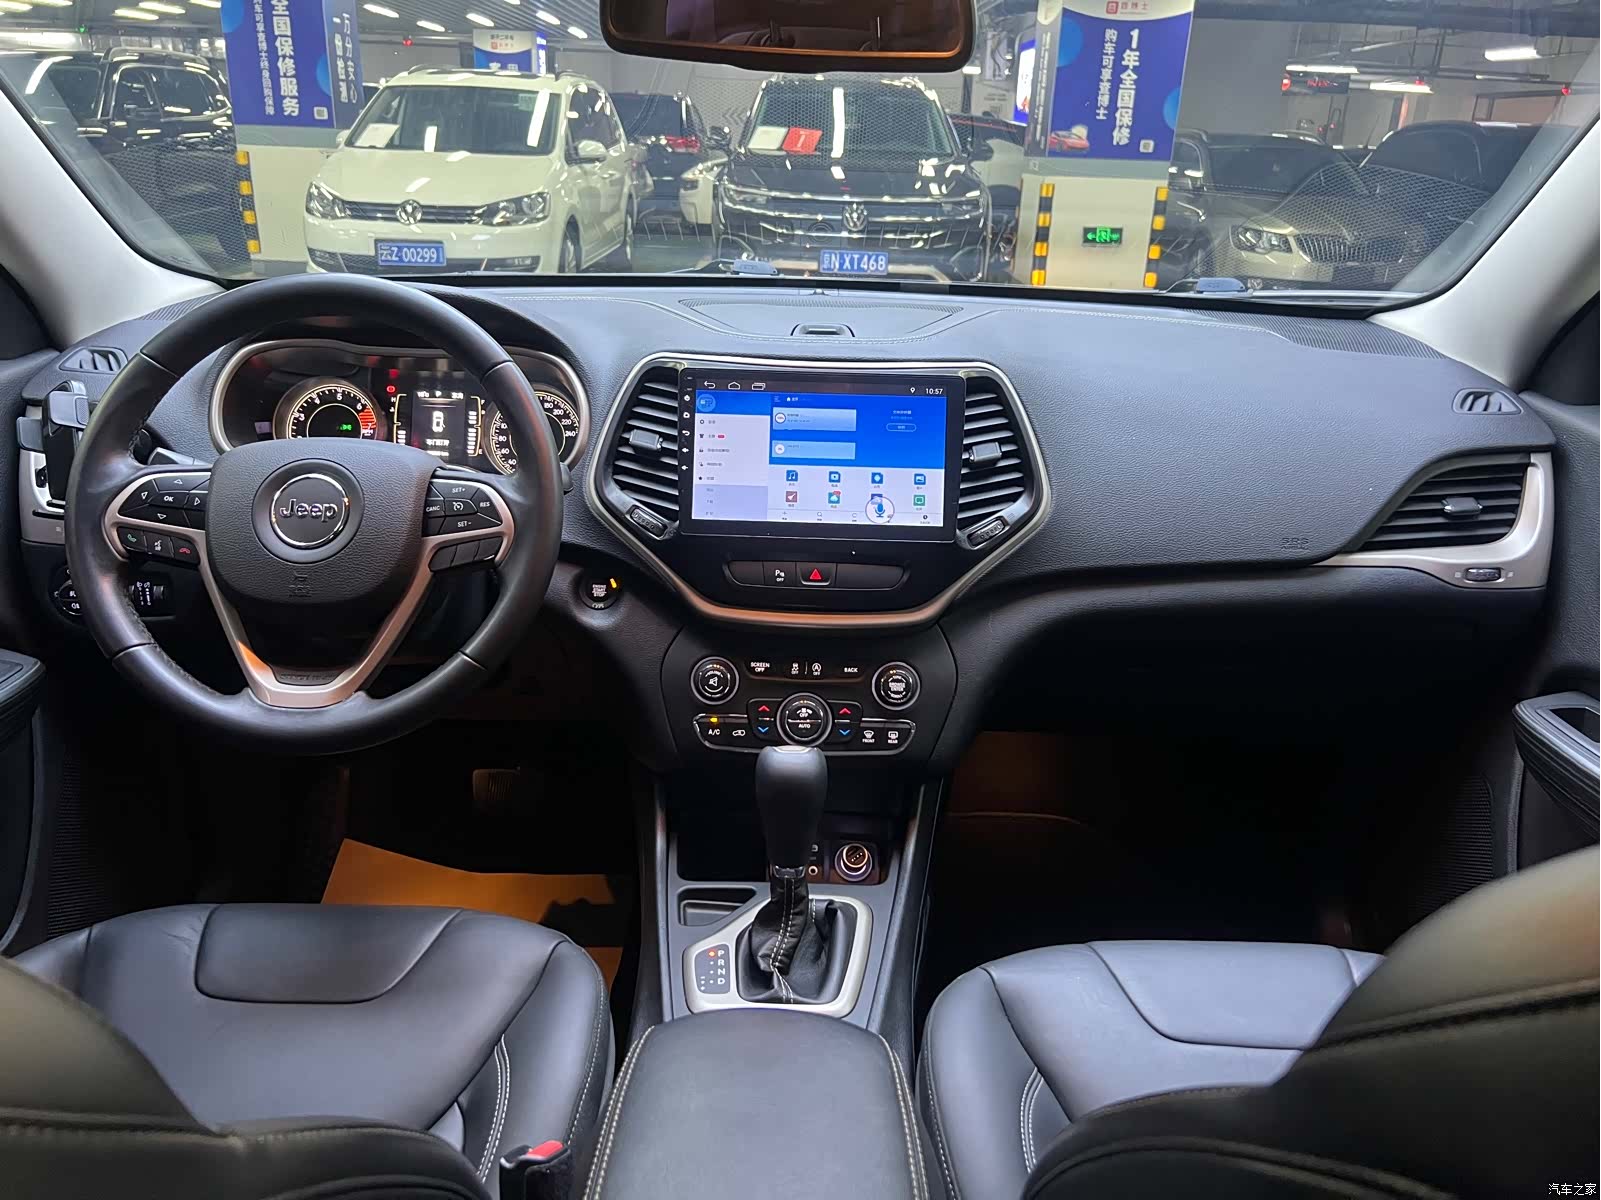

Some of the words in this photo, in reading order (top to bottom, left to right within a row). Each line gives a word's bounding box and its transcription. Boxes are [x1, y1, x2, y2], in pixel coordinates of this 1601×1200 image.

[270, 0, 300, 117] 全国保修服务
[1096, 29, 1118, 119] 购车可享查博士
[1112, 29, 1140, 146] 1年全国保修
[336, 393, 343, 401] 5
[925, 387, 944, 395] 10:57
[279, 498, 339, 524] Jeep
[707, 728, 721, 736] A/C
